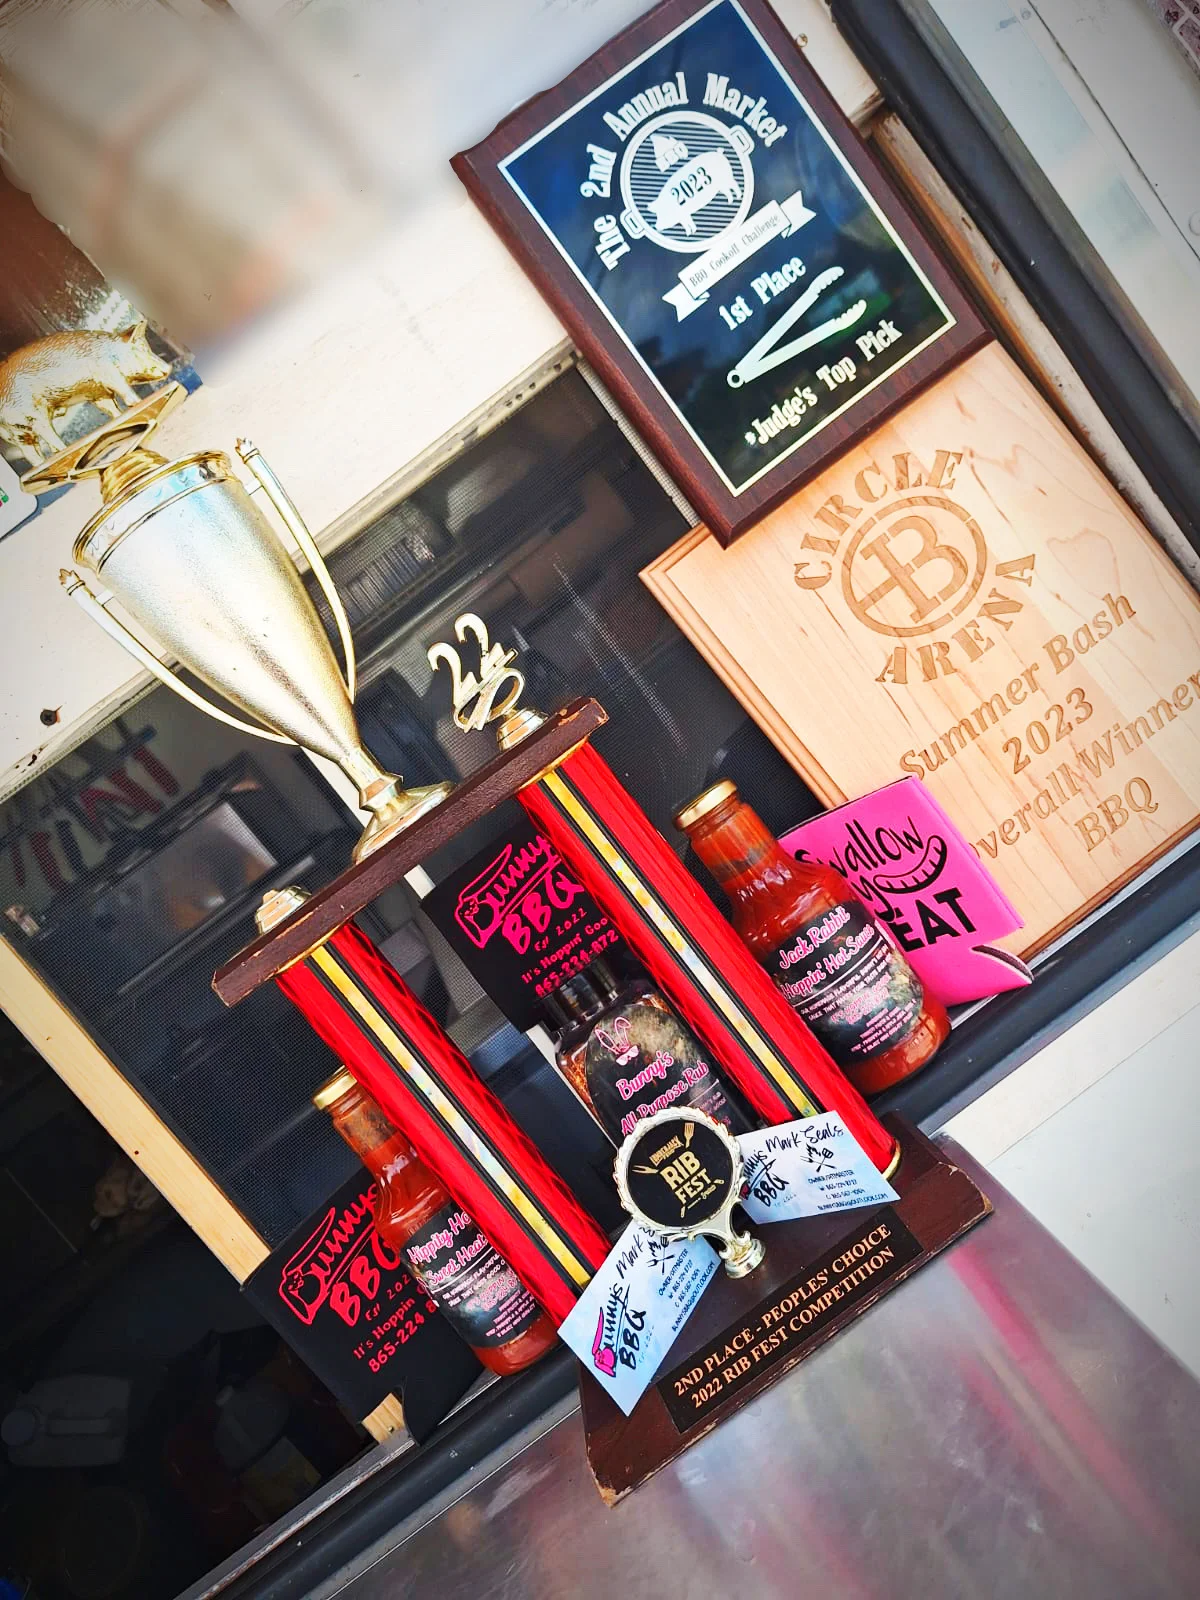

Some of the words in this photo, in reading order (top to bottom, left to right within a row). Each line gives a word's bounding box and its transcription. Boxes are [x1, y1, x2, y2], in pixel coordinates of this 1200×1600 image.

[603, 72, 689, 141] Annual
[703, 72, 788, 147] Market
[580, 143, 616, 198] 2nd
[670, 166, 713, 205] 2023
[595, 214, 631, 271] The
[689, 267, 708, 288] BBQ
[709, 246, 740, 272] Cookoff
[741, 212, 780, 249] Challenge
[719, 295, 753, 331] 1st
[750, 256, 807, 306] Place
[816, 354, 857, 393] Top
[856, 319, 903, 362] Pick
[793, 449, 964, 591] CIRCLE
[874, 553, 1036, 684] ARENA
[898, 661, 1040, 781] Summer
[1041, 592, 1137, 674] Bash
[1002, 686, 1094, 775] 2023
[969, 761, 1081, 859] verall
[1073, 776, 1160, 853] BBQ
[502, 871, 584, 955] BBQ
[556, 907, 588, 935] 2022
[584, 917, 608, 935] Goo
[779, 931, 812, 970] Jack
[806, 905, 851, 952] Rabbit
[892, 887, 977, 952] EAT
[534, 929, 619, 998] 865-224-872
[782, 961, 827, 998] Hoppin'
[824, 946, 853, 977] Hot
[847, 925, 875, 962] Sauce
[615, 1050, 674, 1101] Bunny's
[620, 1105, 641, 1136] All
[636, 1080, 689, 1122] Purpose
[683, 1061, 709, 1089] Rub
[660, 1151, 701, 1190] RIB
[764, 1134, 802, 1153] Mark
[799, 1123, 845, 1146] Seals
[674, 1169, 713, 1205] FEST
[753, 1171, 789, 1208] BBQ
[406, 1226, 455, 1266] Hippity
[448, 1210, 472, 1237] Ho
[428, 1256, 461, 1287] Sweet
[456, 1231, 488, 1266] Heat
[616, 1237, 644, 1280] Mark
[372, 1297, 416, 1340] Hoppin
[386, 1273, 410, 1299] 202
[674, 1366, 704, 1397] 2ND
[704, 1328, 754, 1374] PLACE
[761, 1269, 829, 1329] PEOPLES'
[831, 1224, 892, 1275] CHOICE
[619, 1308, 647, 1370] BBQ
[691, 1378, 723, 1409] 2022
[723, 1357, 752, 1386] RIB
[751, 1331, 789, 1366] FEST
[789, 1246, 896, 1333] COMPETITION
